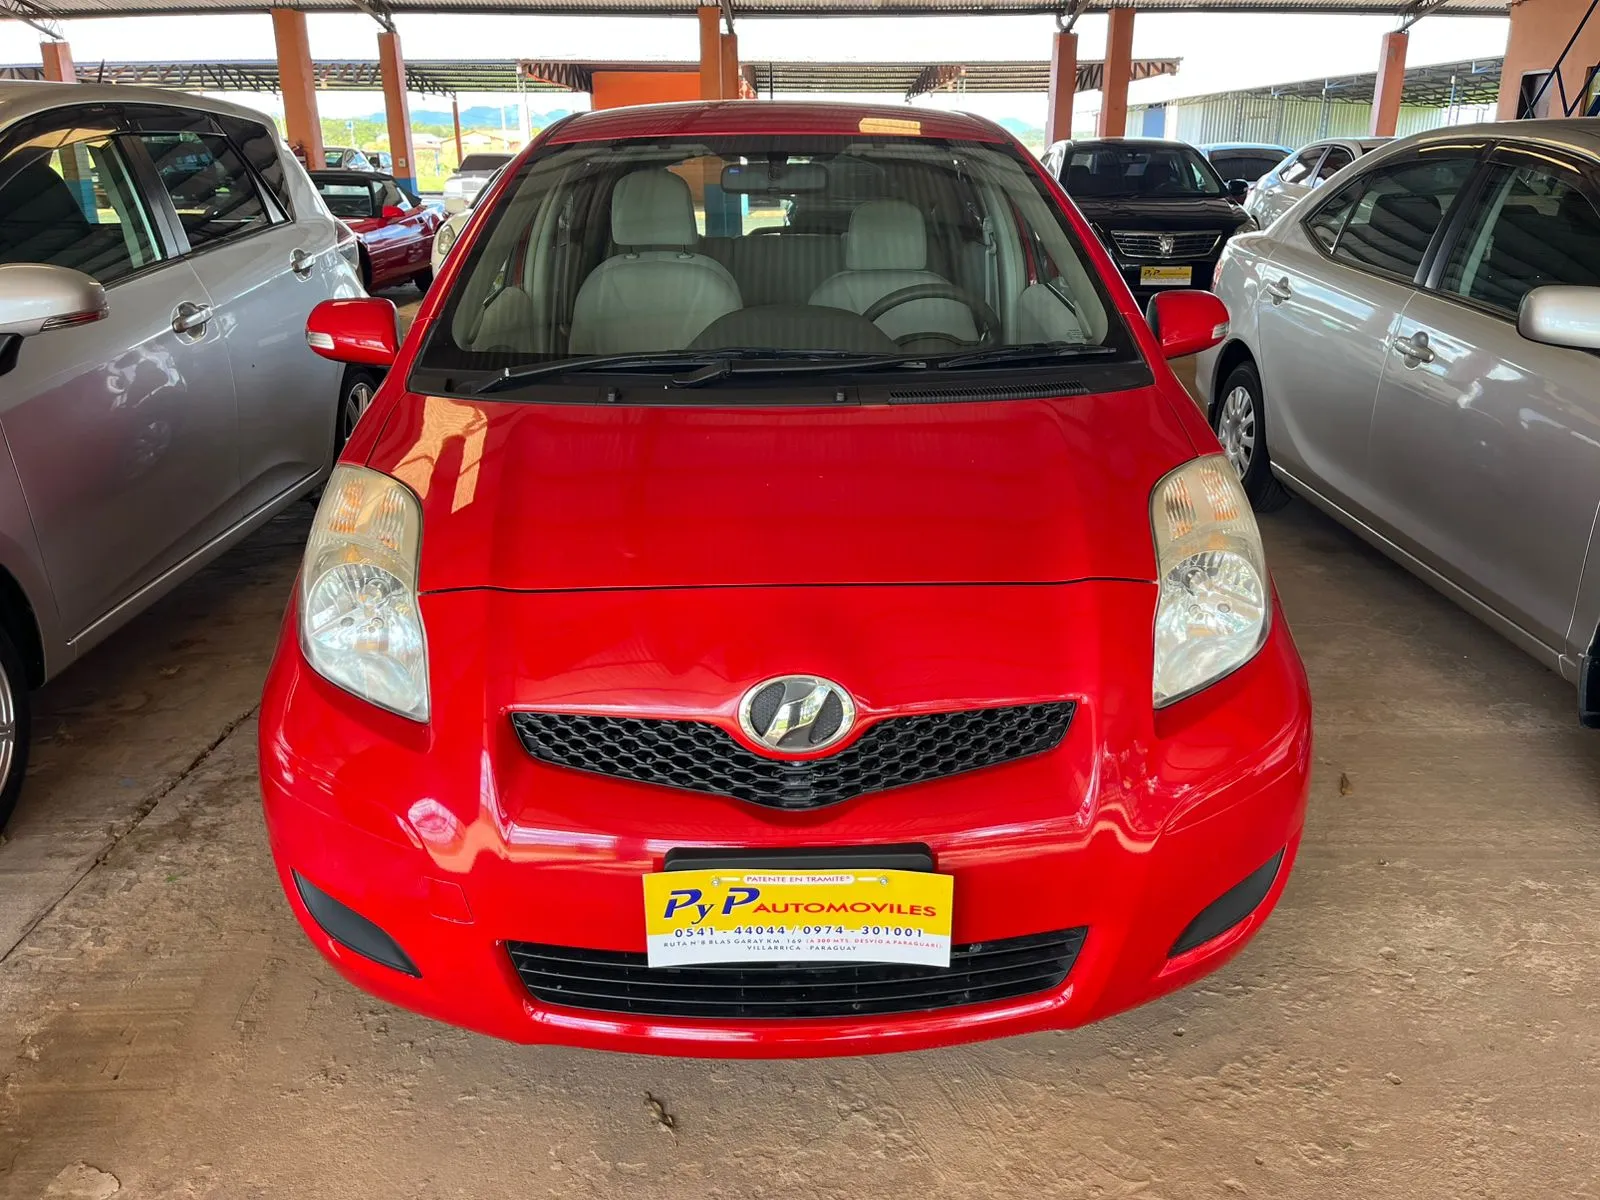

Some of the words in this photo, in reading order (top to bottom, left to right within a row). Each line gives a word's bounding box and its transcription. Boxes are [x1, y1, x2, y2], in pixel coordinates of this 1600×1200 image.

[753, 902, 937, 917] AUTOMOVILES
[675, 927, 714, 937] 0541
[734, 926, 785, 935] 44044
[803, 926, 843, 935] 0974
[862, 926, 922, 937] 301001
